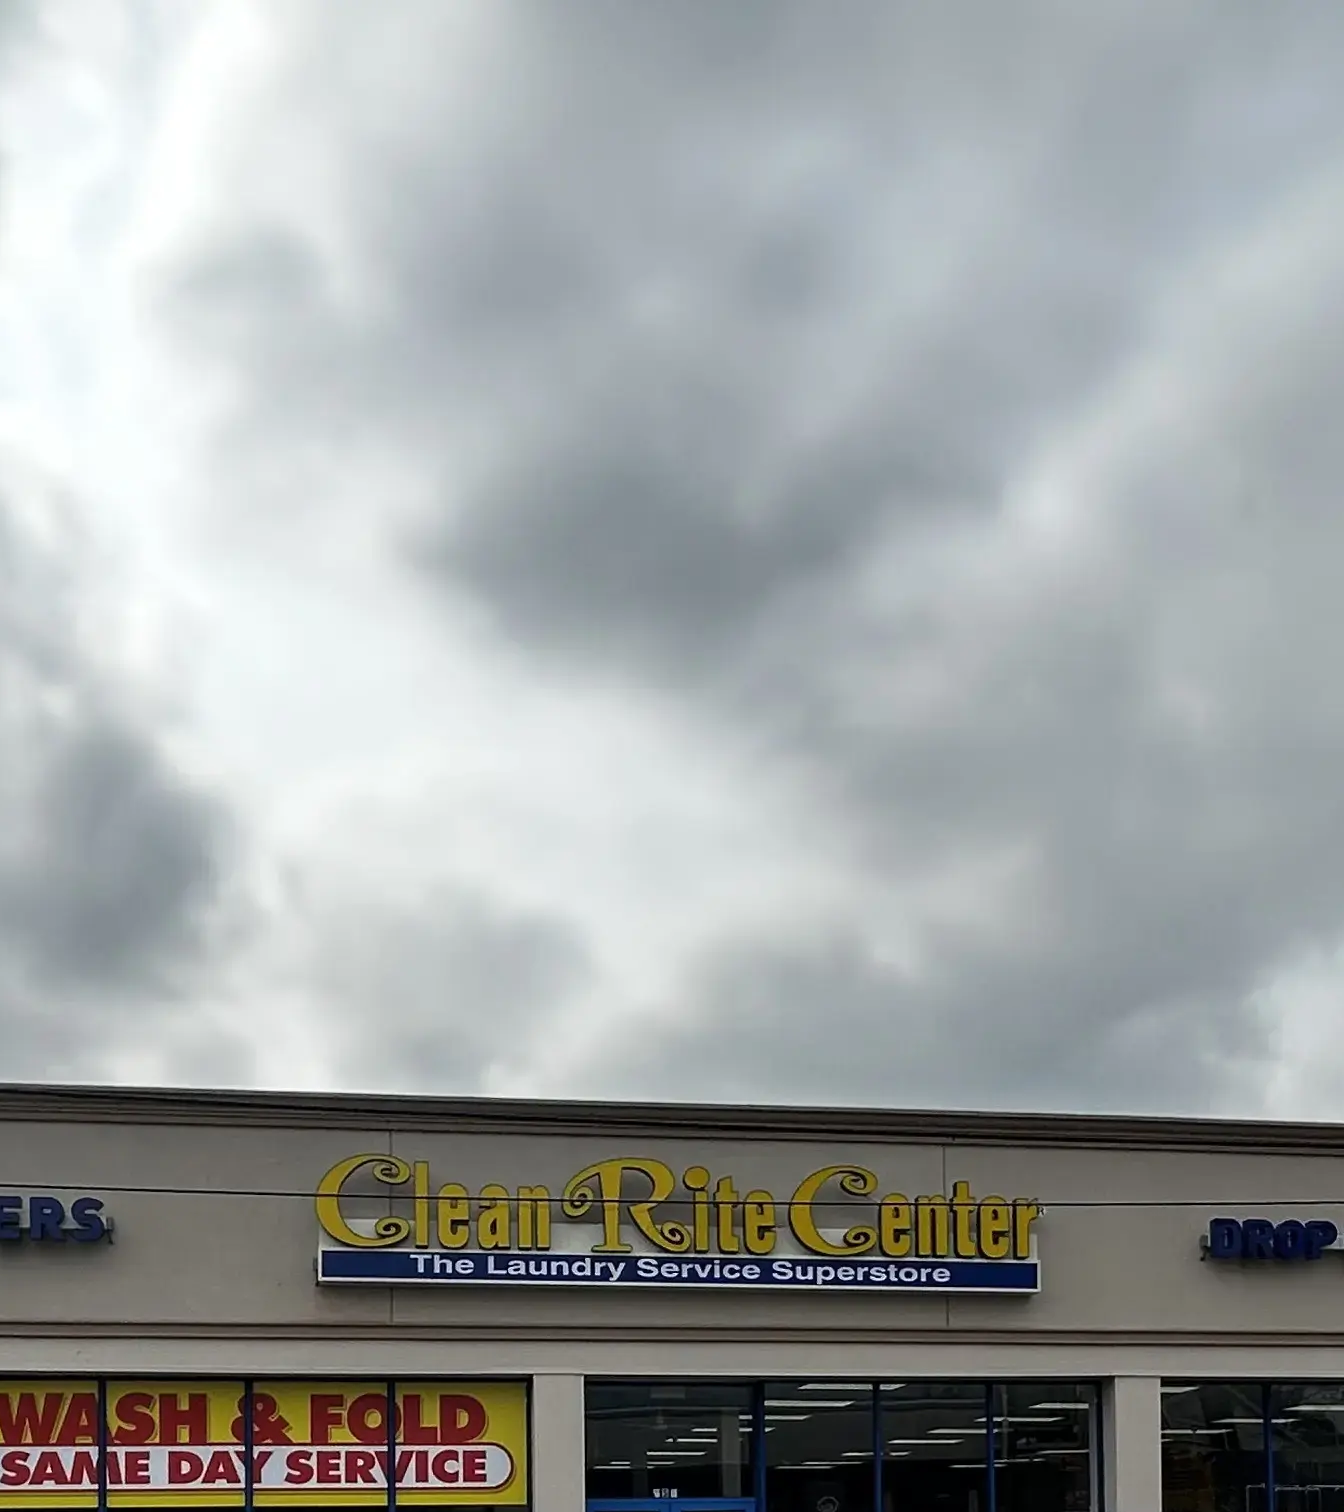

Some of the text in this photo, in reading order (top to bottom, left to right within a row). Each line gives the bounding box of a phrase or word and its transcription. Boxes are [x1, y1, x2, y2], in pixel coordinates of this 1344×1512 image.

[314, 1152, 551, 1251] Clean
[562, 1157, 776, 1256] Rite
[1209, 1217, 1338, 1261] DROP
[409, 1254, 952, 1285] The Laundry Service Superstore
[229, 1391, 294, 1444] &
[310, 1393, 489, 1444] FOLD
[0, 1449, 488, 1485] SAME DAY SERVICE
